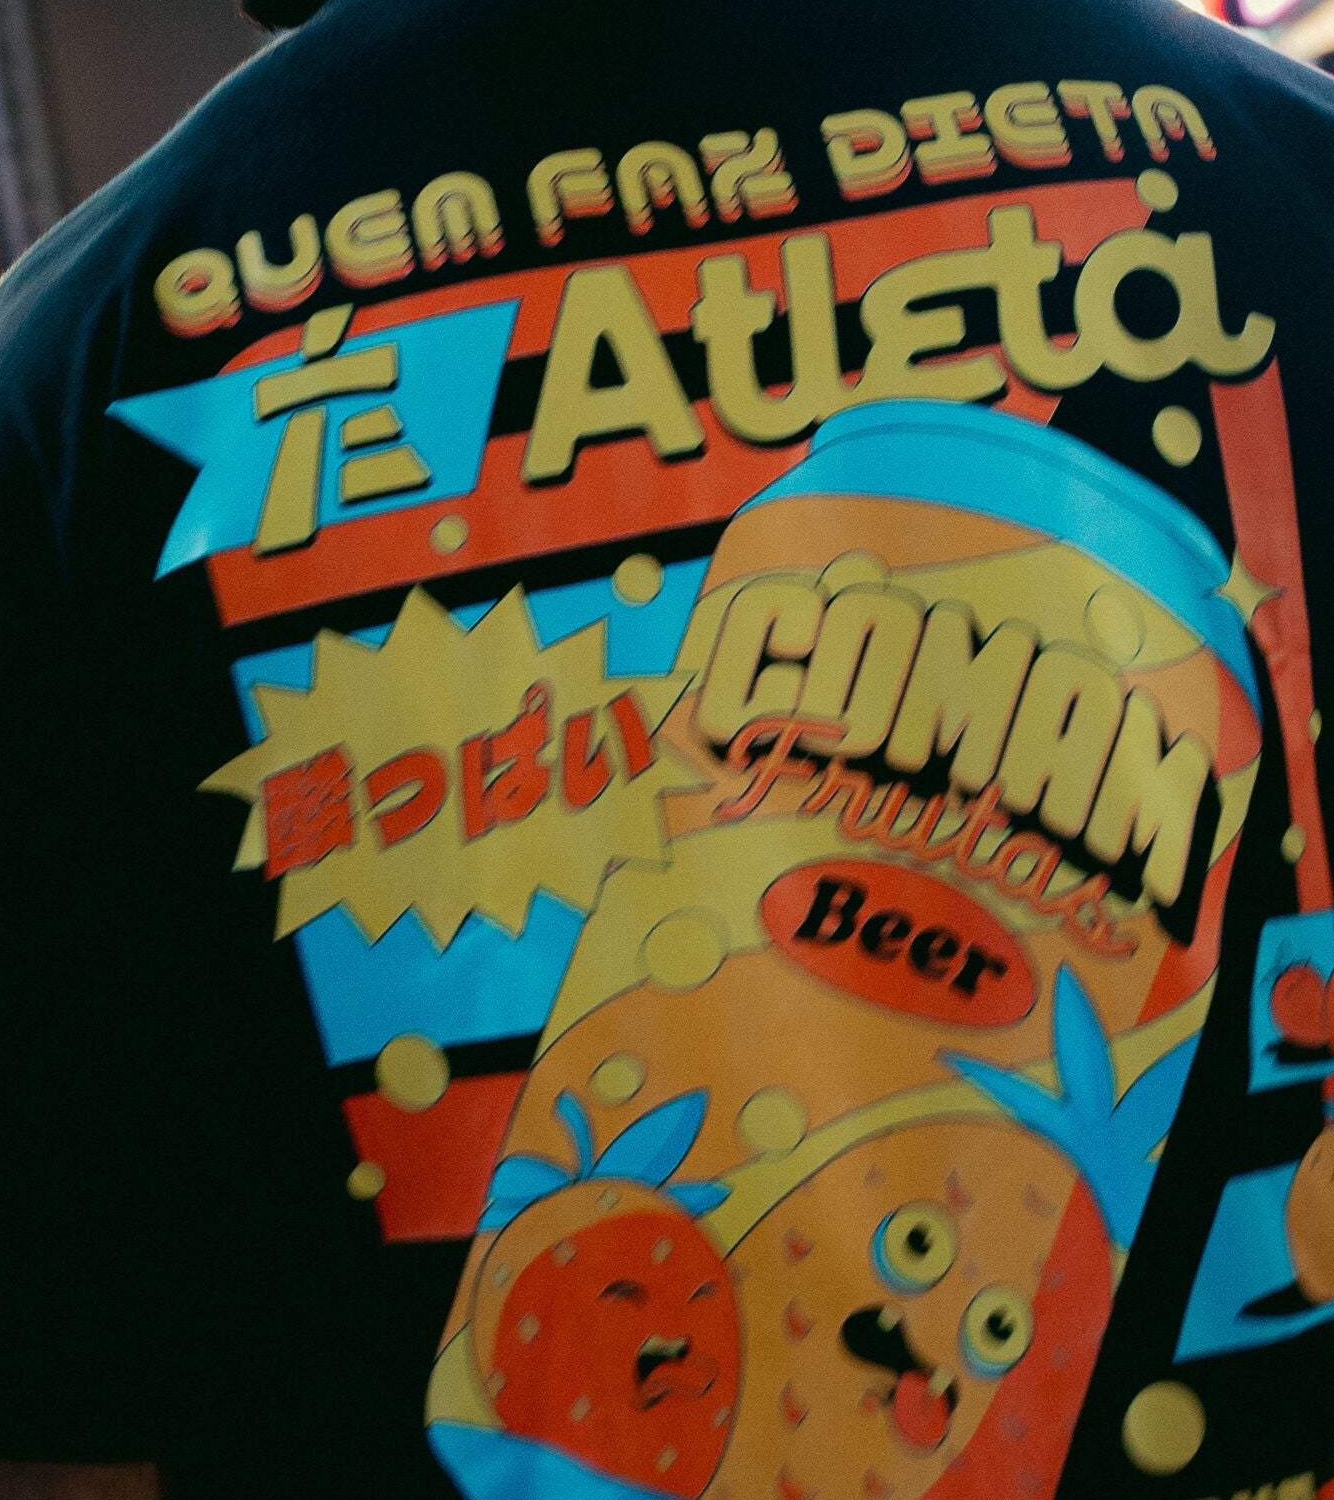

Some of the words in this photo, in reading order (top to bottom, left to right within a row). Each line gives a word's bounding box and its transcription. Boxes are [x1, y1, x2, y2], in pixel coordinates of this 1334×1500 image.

[153, 170, 507, 338] QUEM
[526, 126, 800, 248] FAZ
[819, 78, 1218, 202] DIETA
[520, 203, 1276, 490] Atleta
[695, 576, 1211, 908] COMAM
[713, 714, 1139, 958] Frutas
[791, 874, 1009, 998] Beer
